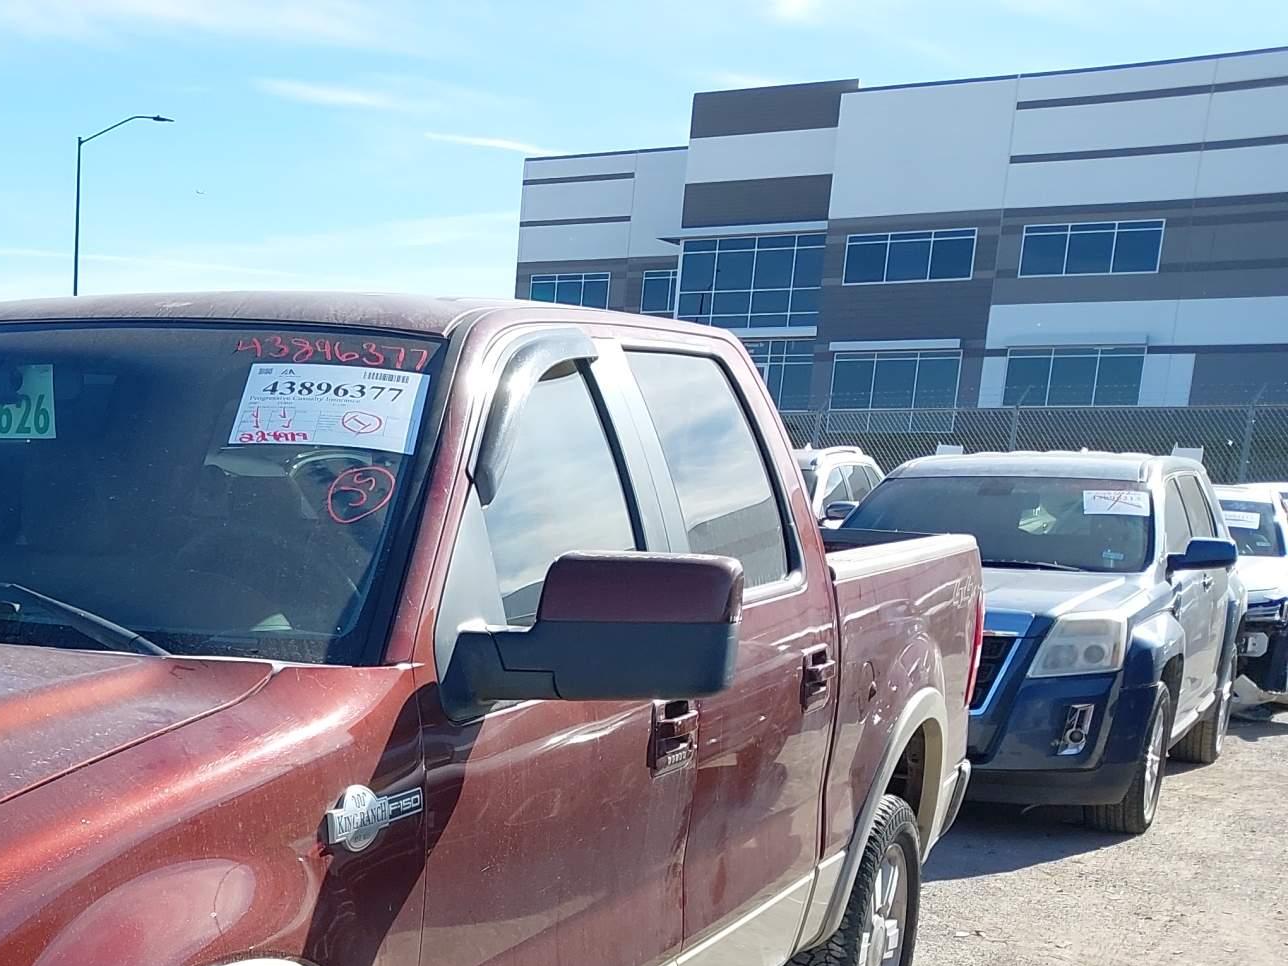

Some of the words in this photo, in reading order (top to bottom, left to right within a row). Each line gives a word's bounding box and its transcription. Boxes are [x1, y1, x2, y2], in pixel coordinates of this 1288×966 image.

[262, 380, 404, 402] 43896377
[337, 813, 359, 835] KING
[359, 799, 387, 828] RANCH
